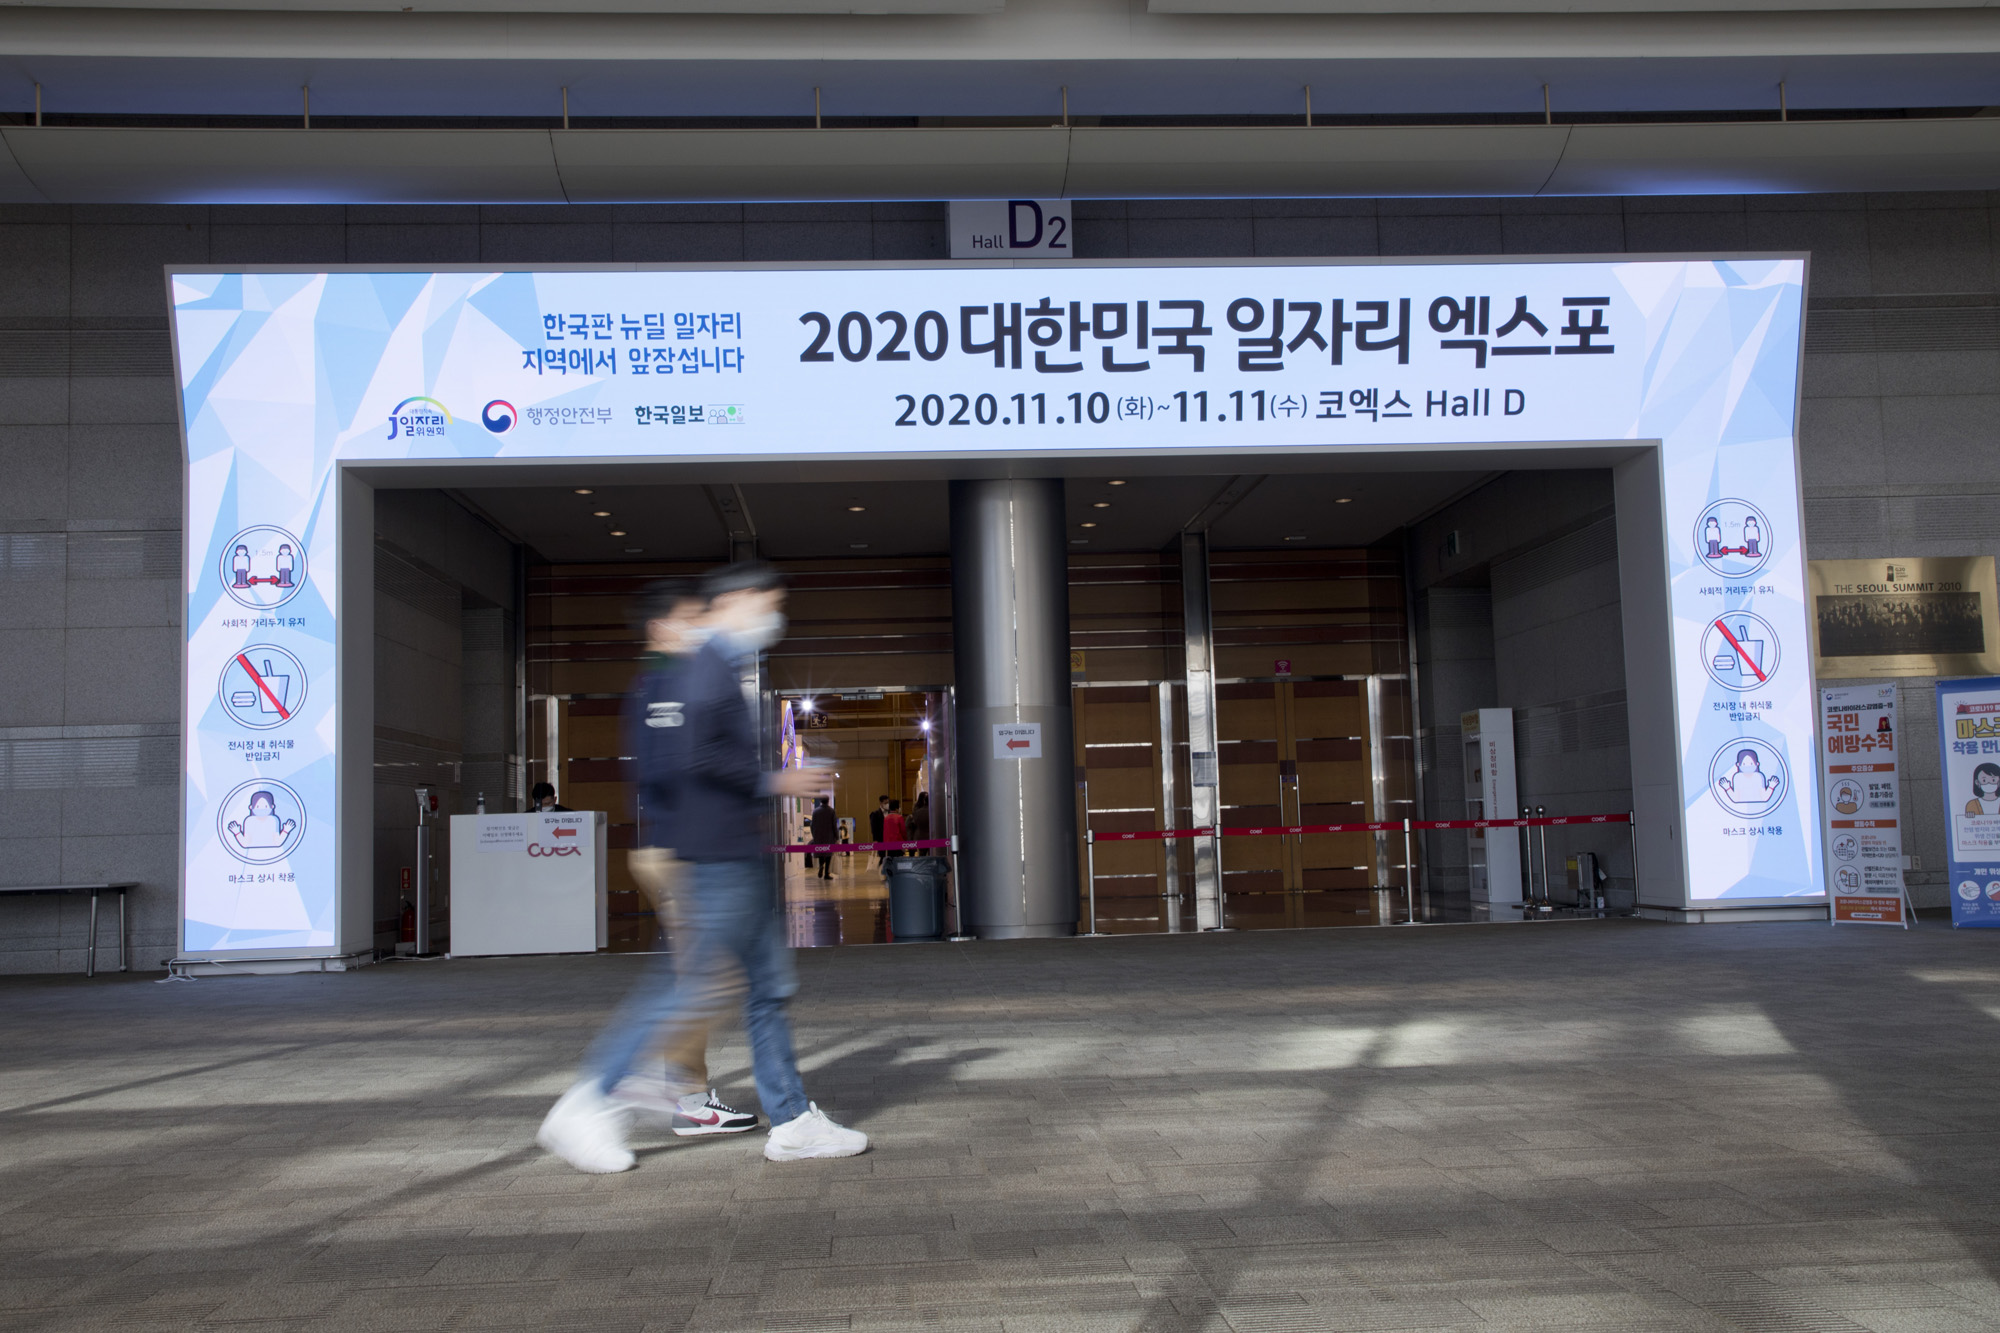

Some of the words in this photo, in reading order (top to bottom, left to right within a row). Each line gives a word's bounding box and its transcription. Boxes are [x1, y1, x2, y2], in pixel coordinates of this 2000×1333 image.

[972, 235, 1004, 248] Hall
[543, 312, 614, 341] 한국판
[620, 312, 665, 340] 뉴딜
[674, 312, 742, 340] 일자리
[799, 310, 949, 363] 2020
[960, 296, 1213, 373] 대한민국
[1226, 297, 1411, 372] 일자리
[1428, 295, 1615, 369] 엑스포
[522, 346, 617, 376] 지역에서
[628, 346, 745, 375] 앞장섭니다
[1316, 388, 1413, 423] 코엑스
[1426, 388, 1490, 417] Hall
[1504, 389, 1526, 416] D
[526, 406, 613, 426] 행정안전부
[634, 405, 705, 425] 한국일보
[1700, 586, 1722, 596] 사회적
[1725, 586, 1756, 596] 거리두기
[1758, 586, 1774, 595] 유지
[1834, 584, 1853, 594] THE
[1857, 584, 1890, 593] SEOUL
[1892, 583, 1934, 592] SUMMIT
[1938, 582, 1962, 591] 2010
[222, 618, 248, 628] 사회적
[251, 618, 286, 628] 거리두기
[288, 616, 306, 628] 유지
[1713, 702, 1736, 712] 전시장
[1739, 702, 1746, 711] 내
[1750, 701, 1772, 711] 취식물
[1827, 702, 1894, 712] 코로나바이러스감염증-19
[1729, 712, 1760, 722] 반입금지
[1827, 712, 1860, 732] 국민
[228, 740, 254, 750] 전시장
[258, 740, 266, 750] 내
[268, 739, 294, 750] 취식물
[1828, 732, 1894, 754] 예방수칙
[1953, 741, 1978, 755] 착용
[246, 751, 280, 762] 반입금지
[1723, 828, 1746, 836] 마스크
[1749, 827, 1764, 836] 상시
[1767, 826, 1783, 836] 착용
[228, 874, 254, 884] 마스크
[257, 873, 275, 884] 상시
[278, 872, 296, 883] 착용
